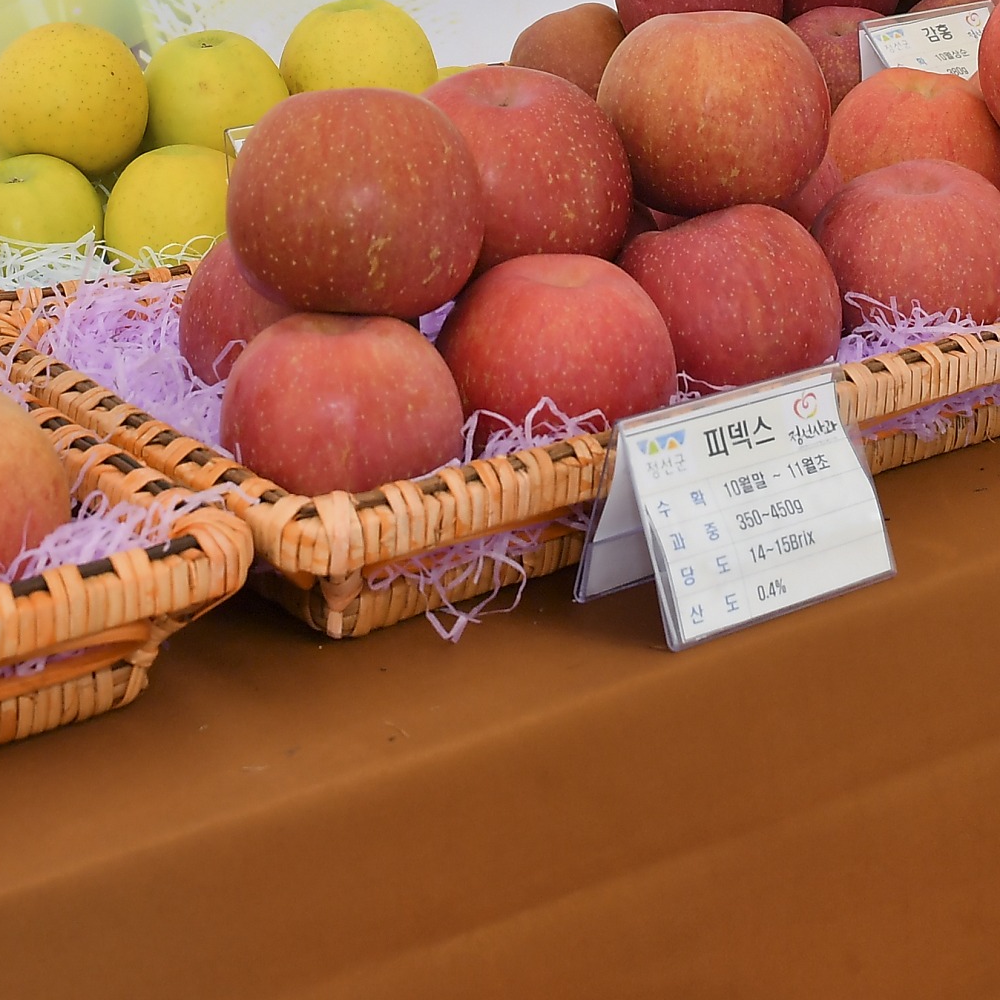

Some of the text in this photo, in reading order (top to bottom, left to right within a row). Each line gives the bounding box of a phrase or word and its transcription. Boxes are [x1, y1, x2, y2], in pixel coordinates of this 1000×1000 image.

[921, 24, 953, 42] 감홍
[703, 416, 775, 457] 피덱스
[788, 419, 838, 446] 정선사과
[647, 453, 687, 479] 정선군
[657, 501, 671, 518] 수
[723, 471, 768, 497] 10월말
[787, 453, 831, 478] 11월초
[736, 499, 804, 530] 350~450g
[749, 530, 816, 563] 14~15Brix
[757, 578, 787, 601] 0.4%
